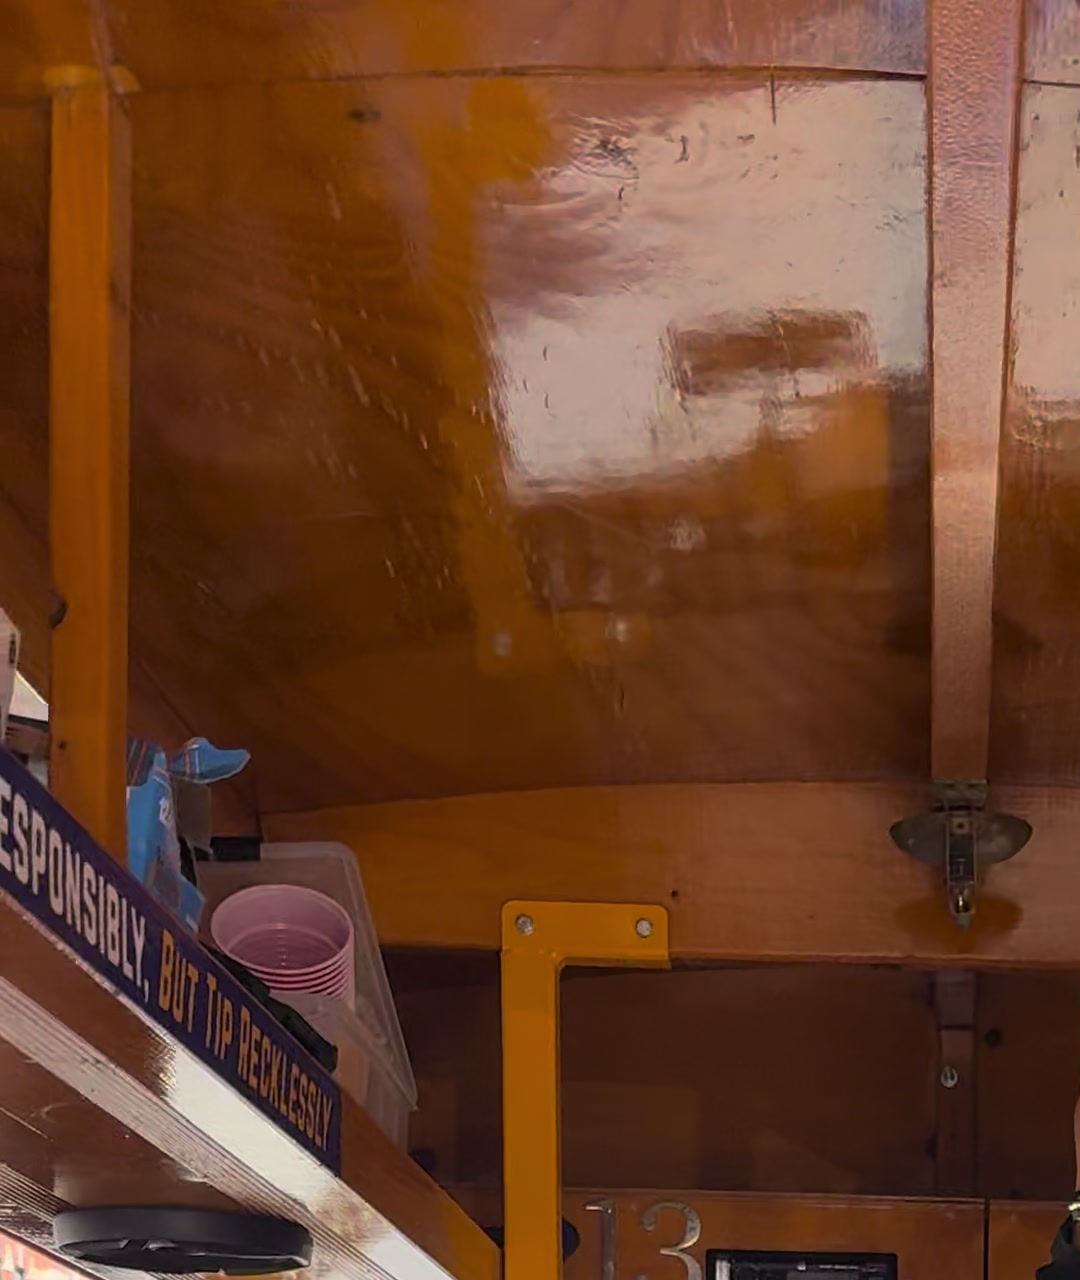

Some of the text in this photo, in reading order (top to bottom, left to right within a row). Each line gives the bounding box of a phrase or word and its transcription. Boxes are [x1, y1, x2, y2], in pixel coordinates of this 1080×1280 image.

[158, 928, 199, 1033] BUT
[205, 973, 234, 1060] TIP
[237, 1004, 333, 1151] RECKLESSLY
